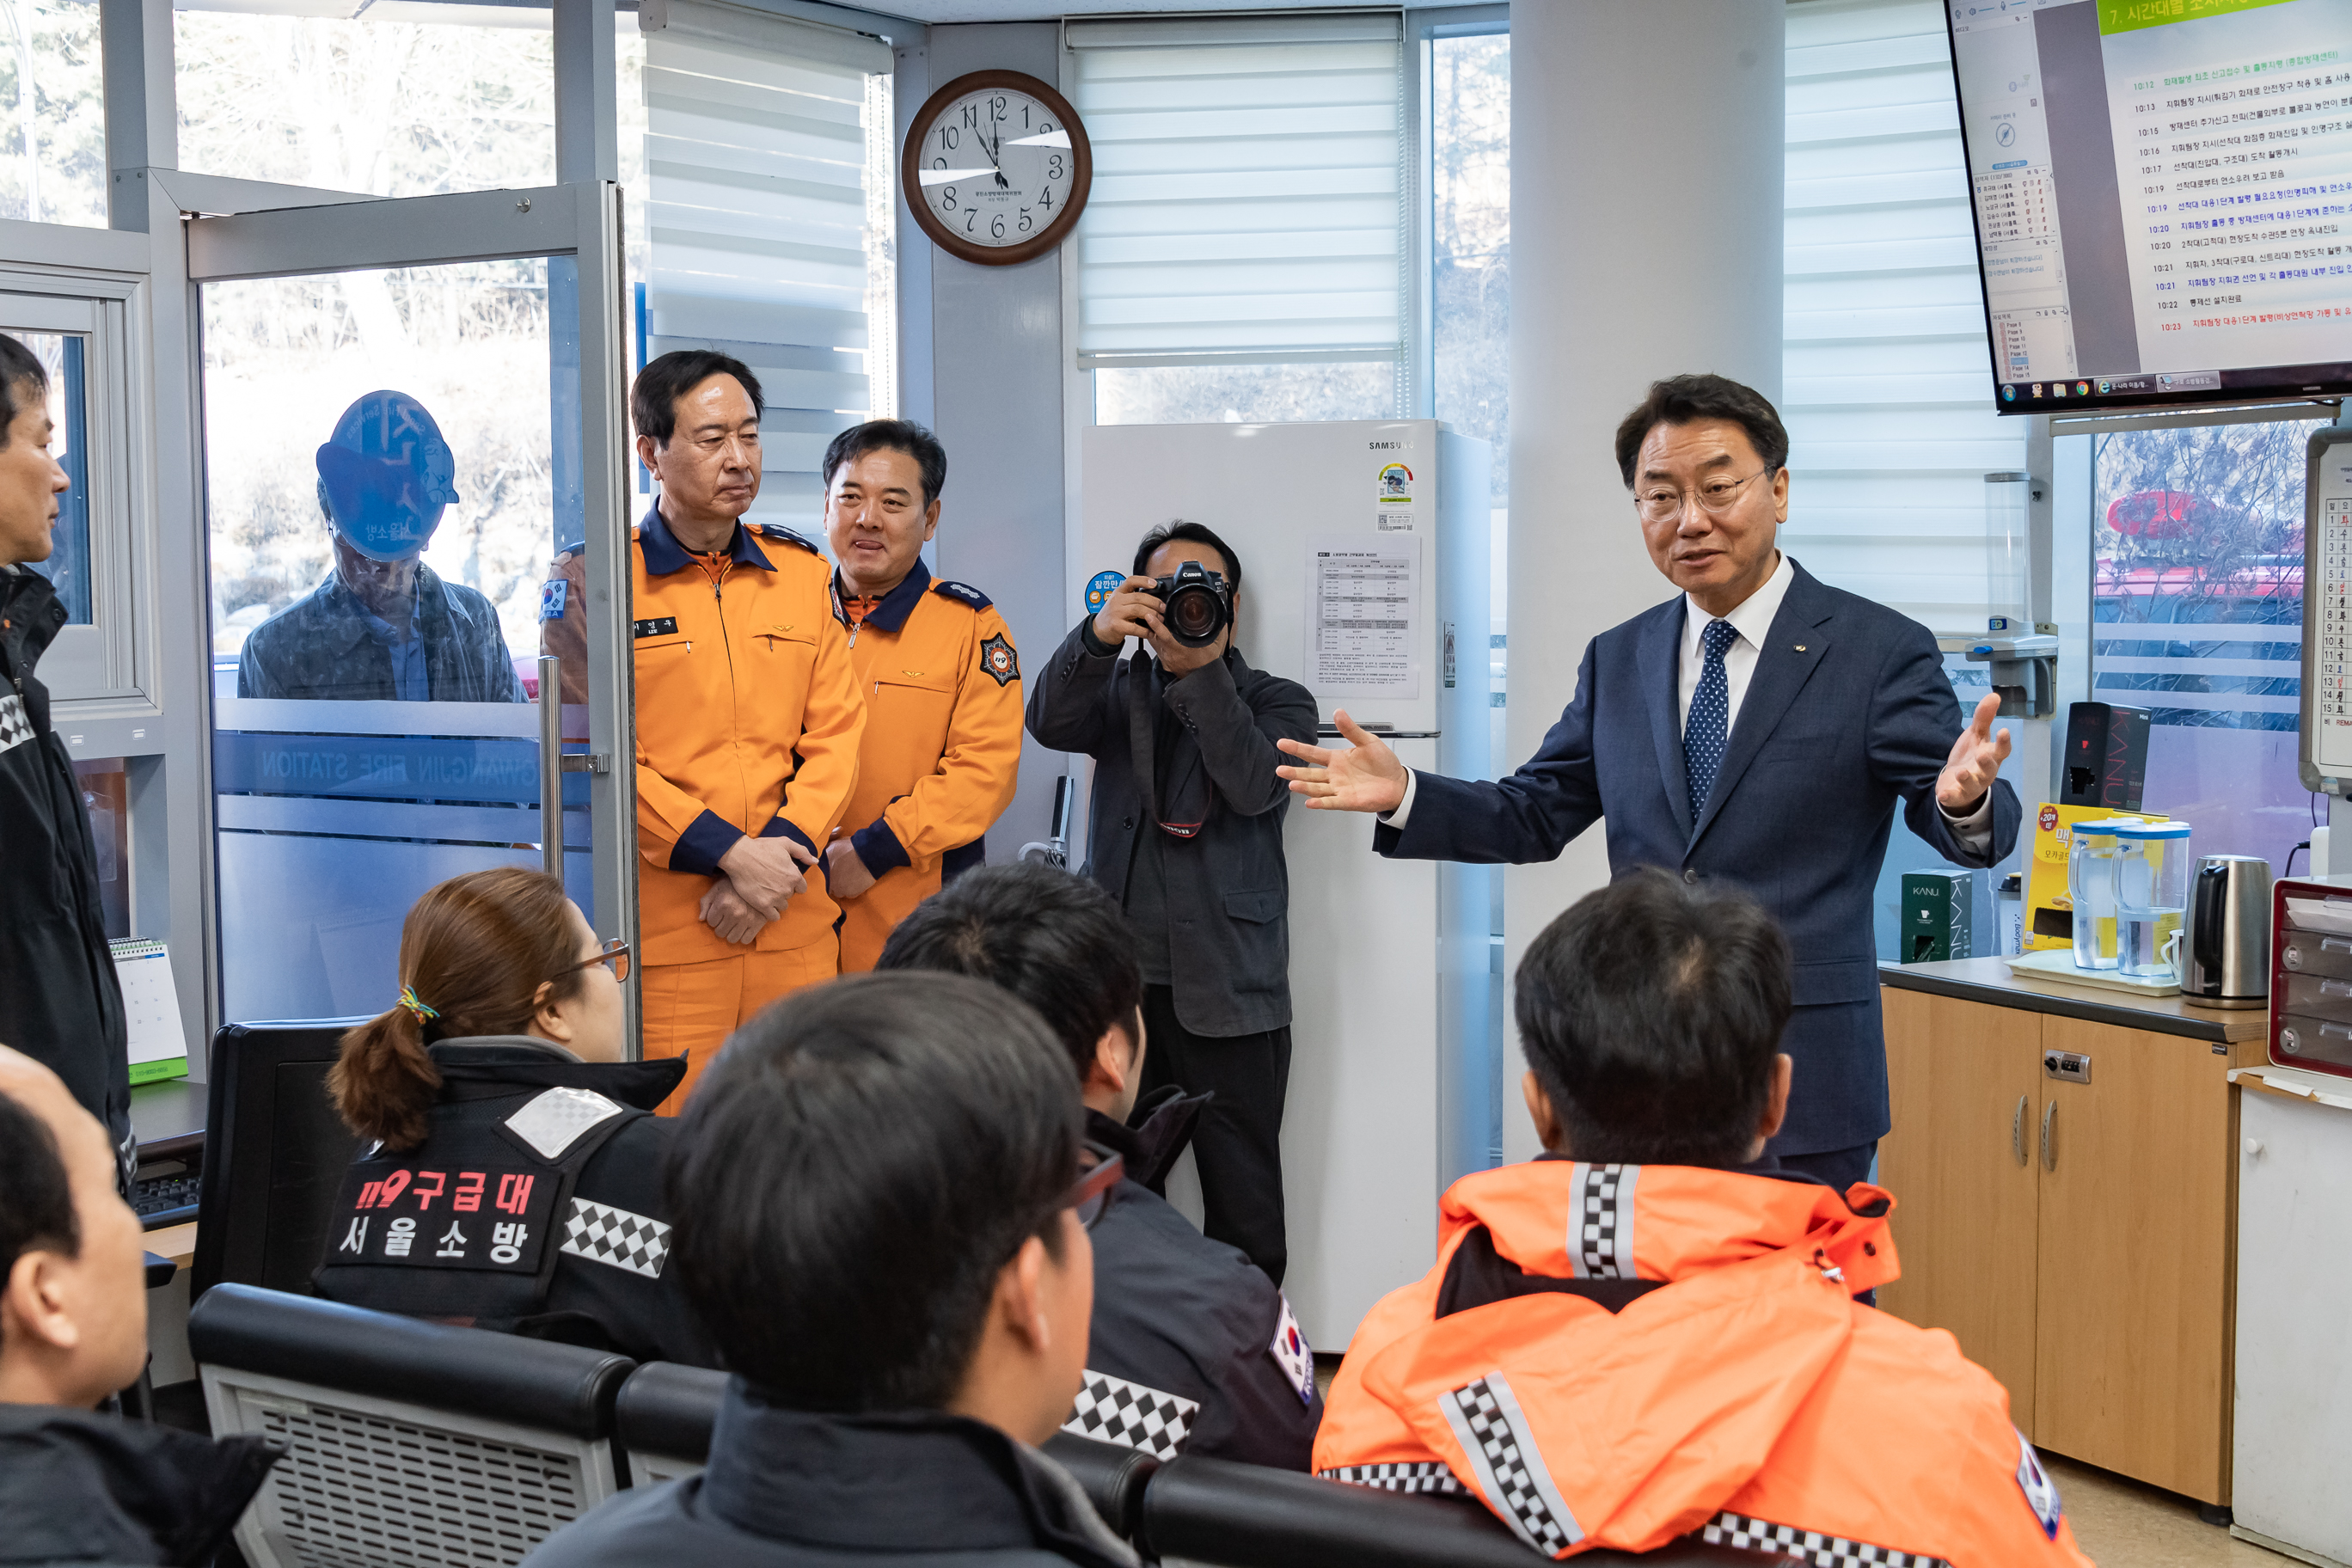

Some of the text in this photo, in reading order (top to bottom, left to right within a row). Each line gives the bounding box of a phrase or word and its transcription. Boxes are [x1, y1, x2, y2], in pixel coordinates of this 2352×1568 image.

[2110, 0, 2184, 25] 7. 시간대별
[2134, 81, 2154, 90] 10:12
[2164, 75, 2191, 86] 화재발생
[2195, 72, 2208, 81] 최초
[2212, 67, 2240, 79] 신고접수
[2243, 65, 2251, 74] 및
[2253, 59, 2282, 72] 출동지령
[2135, 103, 2155, 113] 10:13
[2166, 97, 2195, 108] 지휘팀장
[2239, 87, 2260, 98] 화재로
[2263, 82, 2294, 95] 안전장구
[2296, 79, 2311, 89] 착용
[2314, 77, 2322, 86] 및
[960, 104, 977, 130] 11
[987, 96, 1008, 122] 12
[1020, 104, 1030, 130] 1
[2138, 127, 2159, 137] 10:15
[2169, 119, 2198, 132] 방재센터
[2200, 115, 2229, 127] 추가신고
[2289, 103, 2312, 114] 불꽃과
[2314, 99, 2337, 111] 농연이
[939, 125, 959, 150] 10
[2140, 147, 2160, 156] 10:16
[2171, 142, 2200, 153] 지휘팀장
[2244, 132, 2265, 144] 화점층
[2268, 128, 2299, 139] 화재진압
[2300, 126, 2308, 136] 및
[2311, 121, 2343, 134] 인명구조
[1048, 154, 1063, 180] 3
[2141, 165, 2161, 175] 10:17
[2223, 155, 2248, 166] 구조대)
[2251, 152, 2265, 162] 도착
[2269, 147, 2298, 159] 활동개시
[2144, 169, 2285, 194] 10:19 선착대로부터 연소우려 보고 받음
[942, 186, 957, 211] 8
[1038, 185, 1055, 211] 4
[2147, 204, 2167, 213] 10:19
[2177, 200, 2199, 211] 선착대
[2201, 196, 2234, 208] 대응1단계
[2237, 194, 2251, 204] 발령
[2319, 185, 2327, 194] 및
[964, 207, 978, 232] 7
[990, 214, 1005, 238] 6
[1018, 206, 1032, 232] 5
[2149, 224, 2169, 234] 10:20
[2180, 220, 2209, 230] 지휘팀장
[2211, 218, 2225, 228] 출동
[2238, 212, 2275, 224] 방재센터에
[2276, 207, 2319, 220] 대응1단계에
[2322, 205, 2345, 216] 준하는
[2150, 242, 2171, 250] 10:20
[2229, 233, 2258, 244] 현장도착
[2289, 228, 2306, 238] 연장
[2308, 224, 2338, 235] 옥내진입
[2153, 264, 2173, 273] 10:21
[2294, 248, 2324, 259] 현장도착
[2327, 246, 2342, 255] 활동
[2156, 282, 2175, 291] 10:21
[2188, 277, 2216, 287] 지휘팀장
[2218, 275, 2239, 285] 지휘권
[2242, 273, 2257, 283] 선언
[2258, 273, 2266, 281] 및
[2269, 272, 2276, 280] 각
[2279, 268, 2308, 279] 출동대원
[2311, 266, 2326, 276] 내부
[2329, 265, 2344, 275] 진입
[2158, 294, 2242, 309] 10:22 통제선 설치완료
[2161, 322, 2181, 332] 10:23
[2192, 318, 2221, 328] 지휘팀장
[2223, 315, 2257, 326] 대응1단계
[2316, 309, 2331, 318] 가동
[2334, 308, 2342, 317] 및
[2329, 542, 2334, 551] 3
[2329, 556, 2334, 565] 4
[2329, 570, 2334, 579] 5
[2327, 610, 2332, 619] 8
[2324, 677, 2333, 686] 13
[2104, 709, 2130, 805] KANU
[2056, 829, 2073, 849] 맥
[1913, 887, 1939, 897] KANU
[355, 1169, 534, 1215] 119구급대
